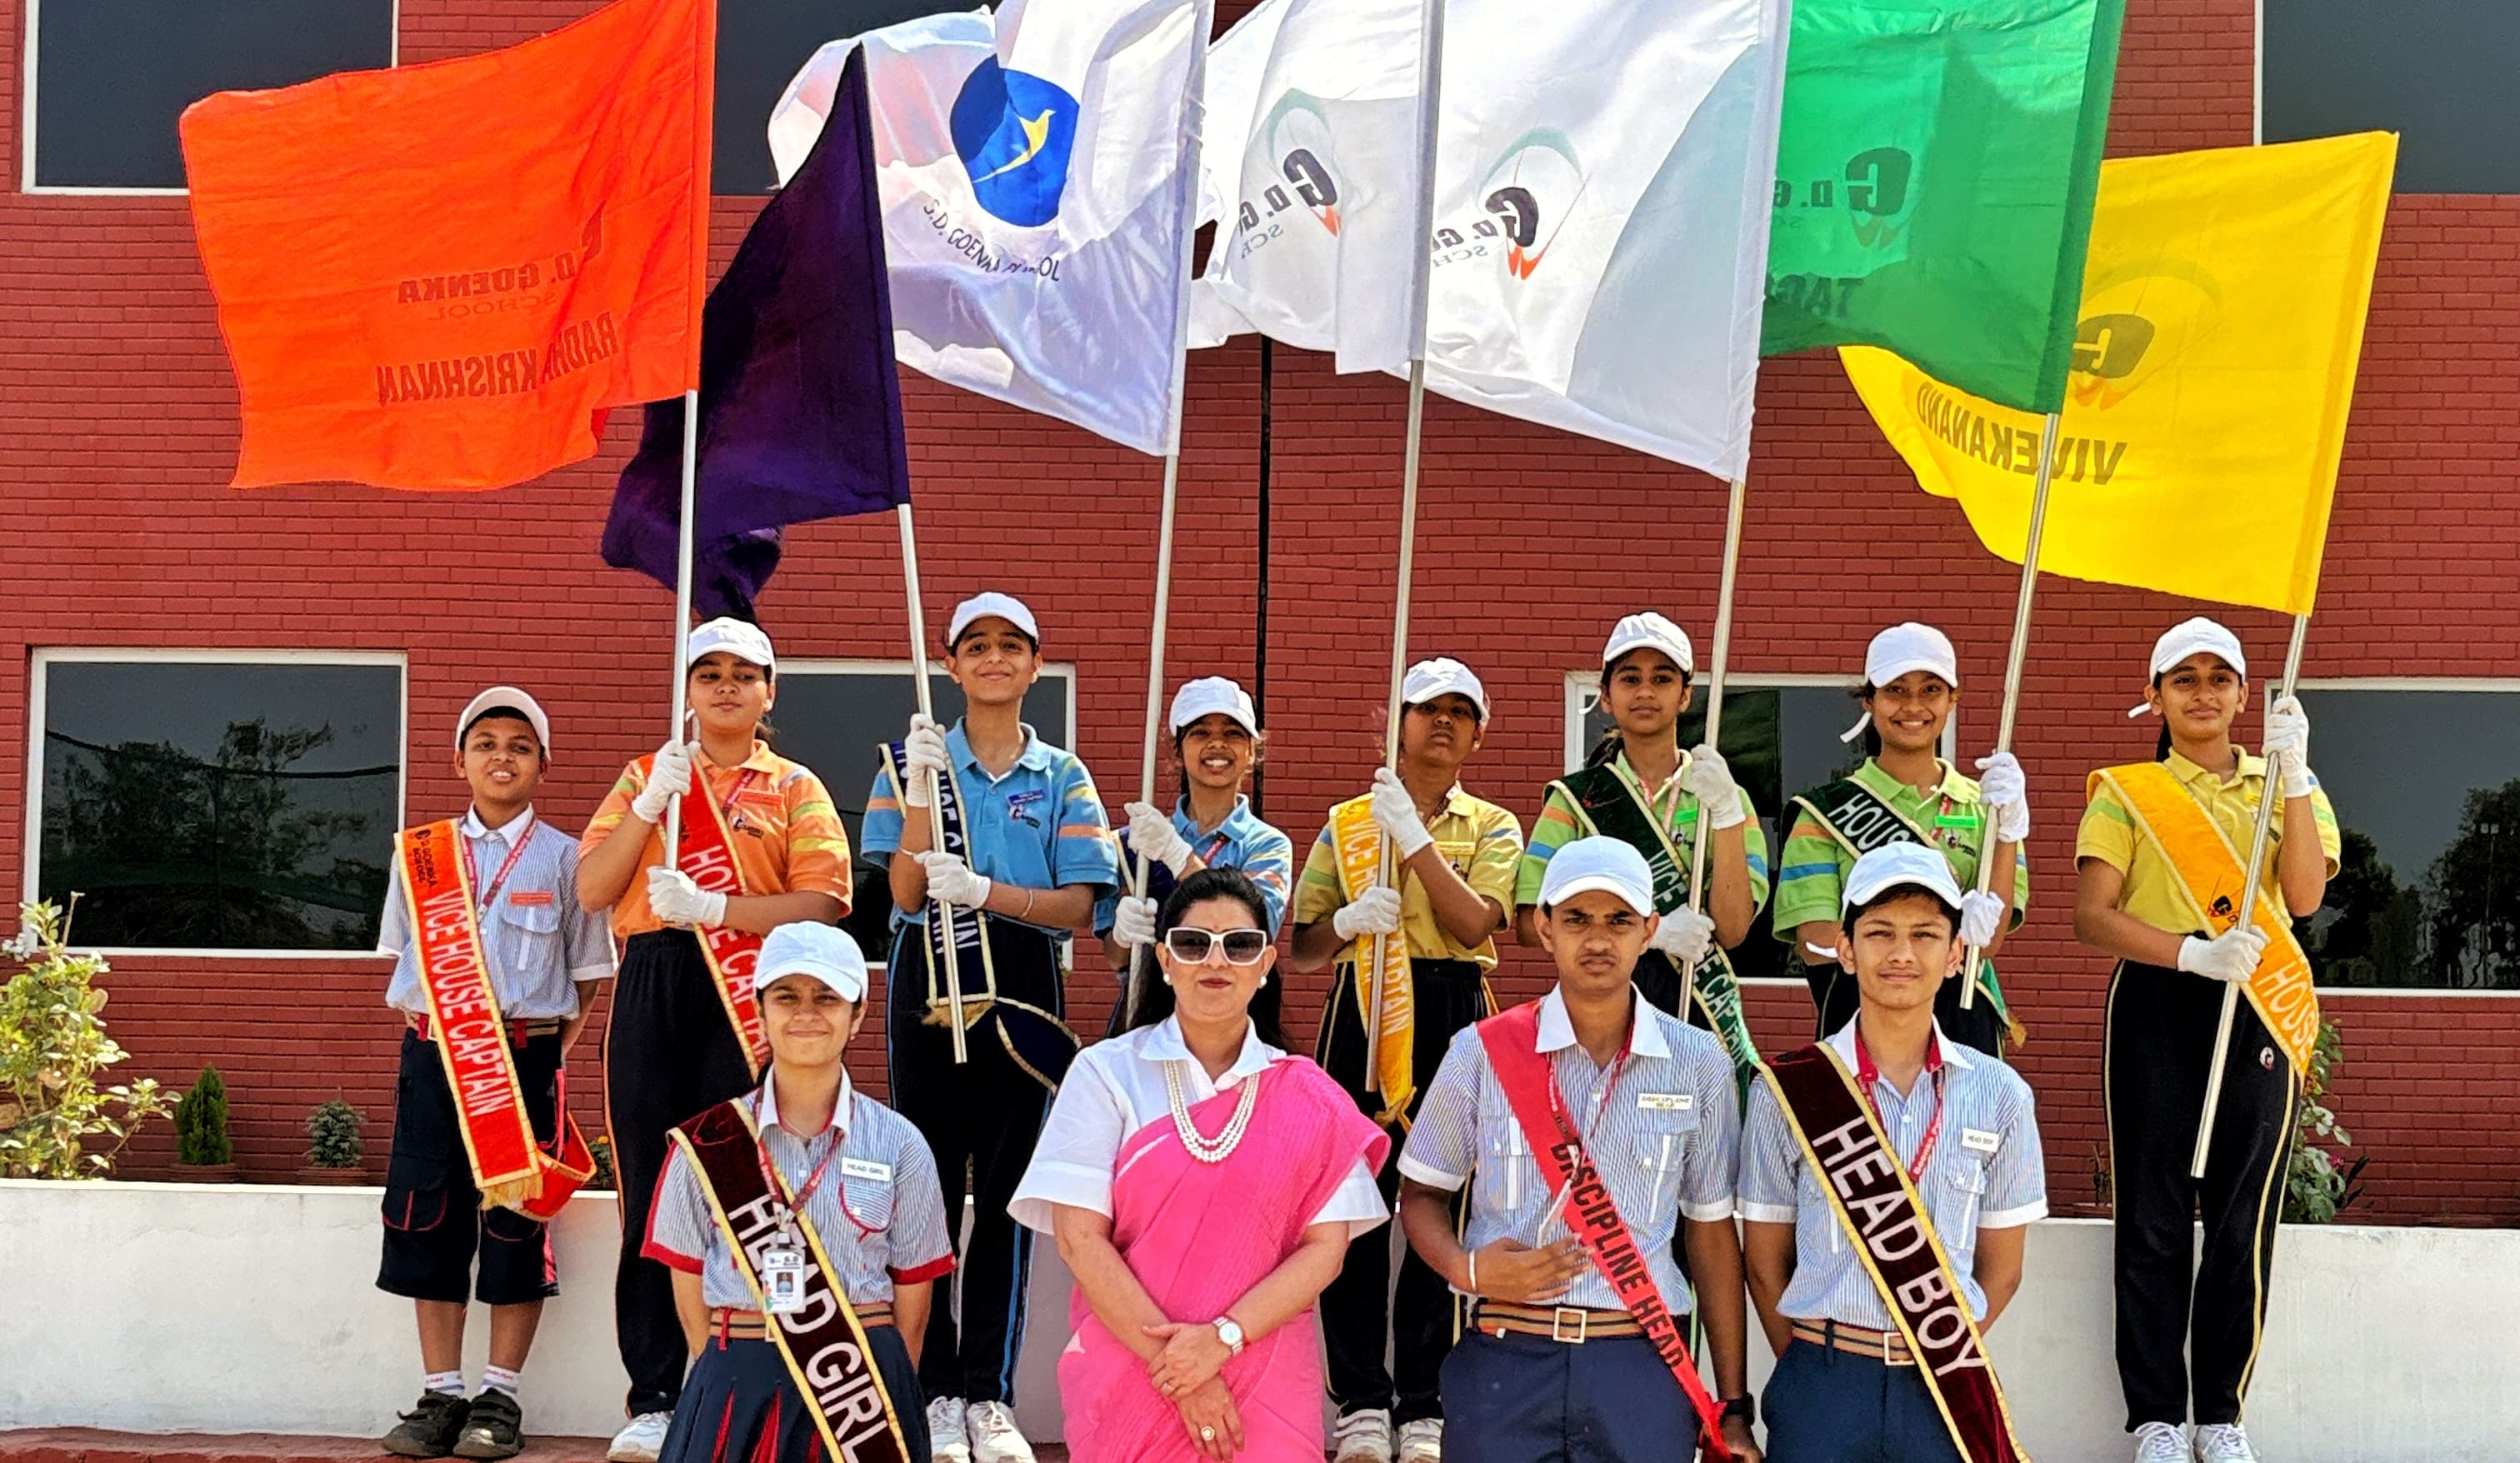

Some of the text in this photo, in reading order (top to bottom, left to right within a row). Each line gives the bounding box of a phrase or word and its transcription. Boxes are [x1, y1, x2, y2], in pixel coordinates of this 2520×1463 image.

[947, 227, 1000, 273] GOEN
[1827, 792, 1911, 851] HOU
[422, 887, 514, 1118] VICE HOUSE CAPTAIN
[727, 1193, 889, 1463] HED GIRL
[1549, 1137, 1684, 1370] DISCIPLINE HEAD
[1811, 1115, 1988, 1377] HEAD BOY
